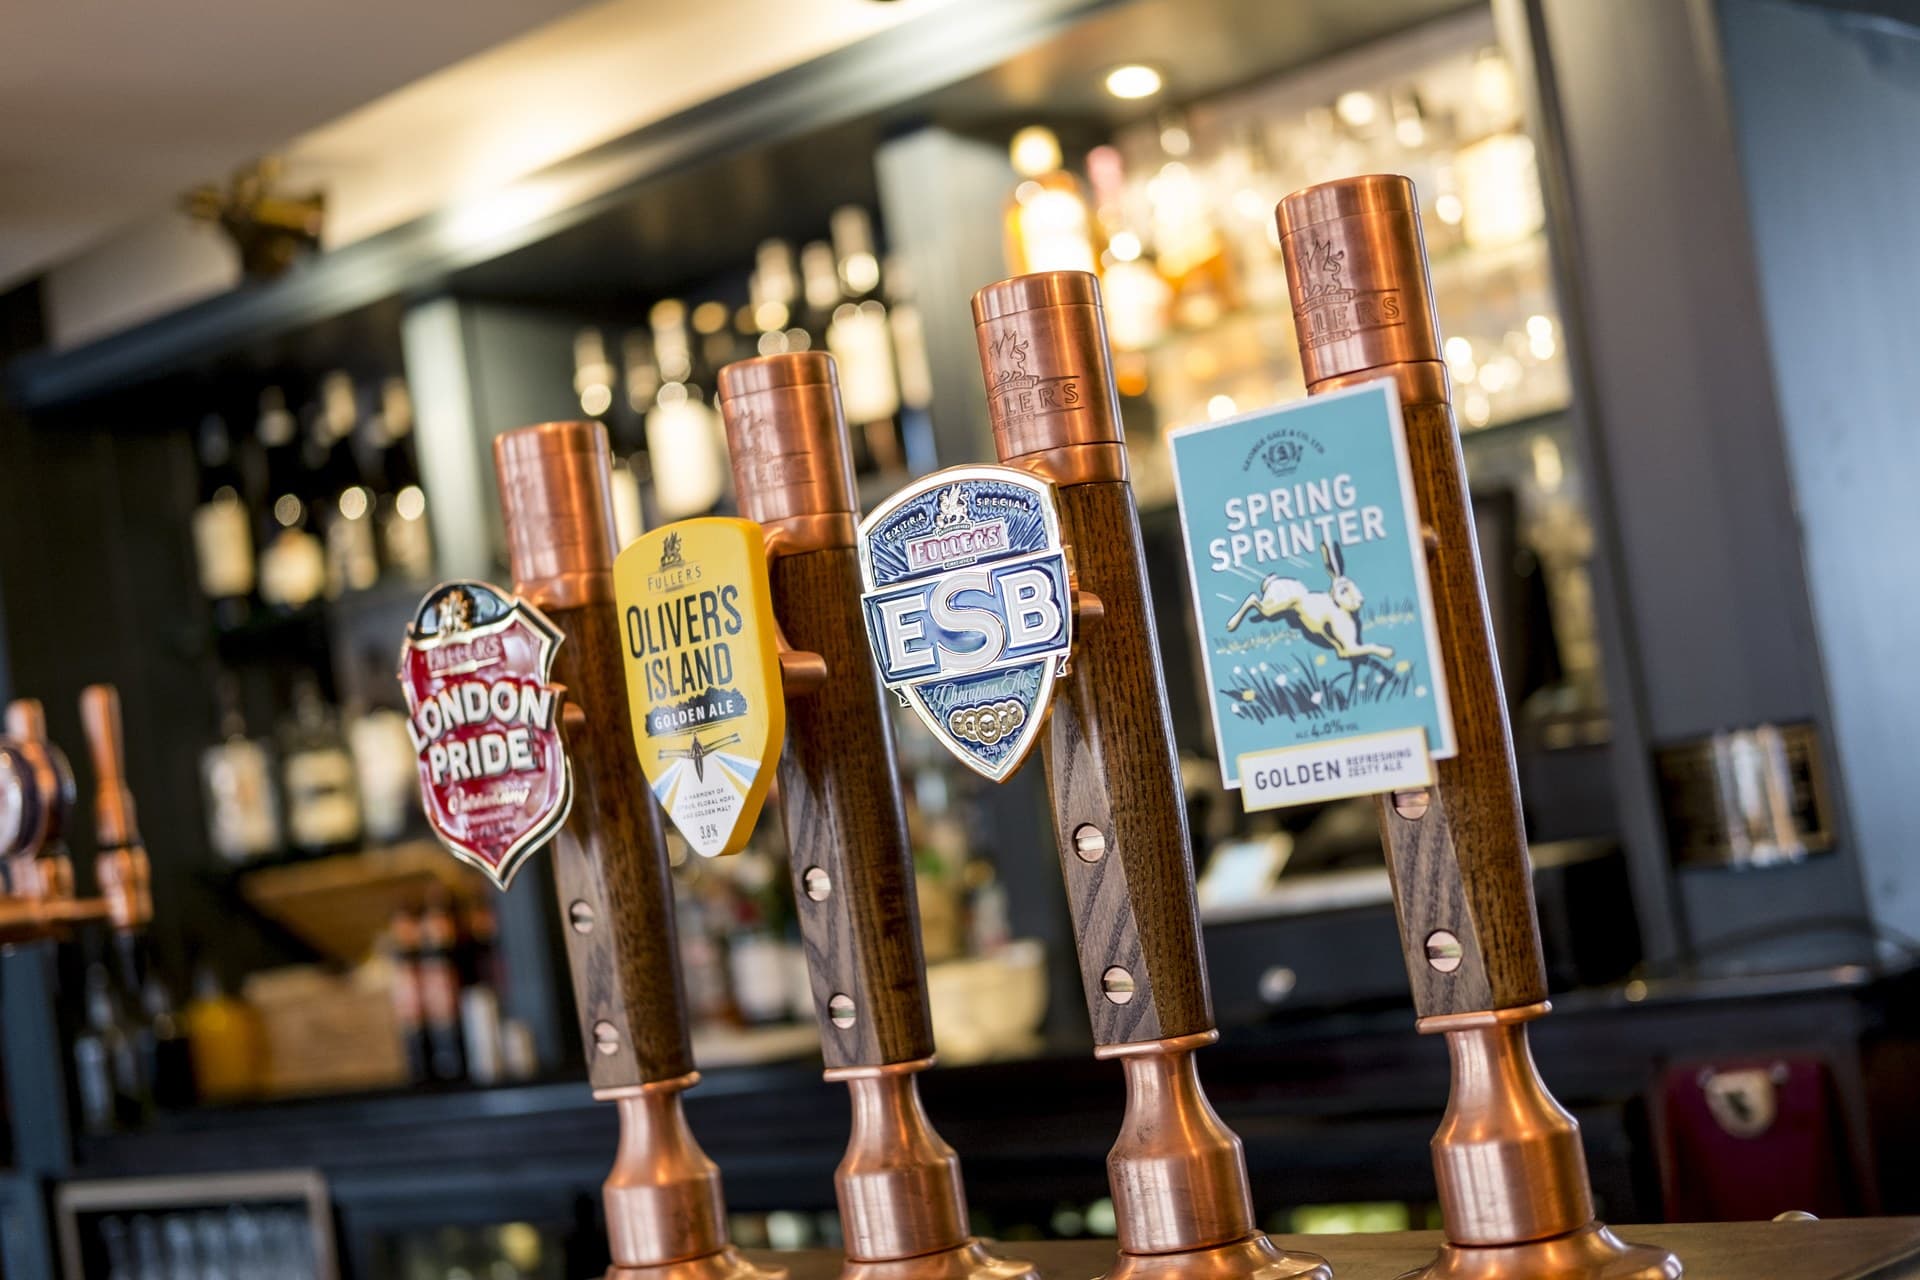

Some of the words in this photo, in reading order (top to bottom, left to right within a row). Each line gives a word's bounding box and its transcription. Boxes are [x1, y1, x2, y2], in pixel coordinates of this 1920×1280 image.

[885, 513, 927, 542] EXTRA
[976, 496, 1030, 512] SPECIAL
[1225, 473, 1356, 532] SPRING
[1209, 505, 1387, 572] SPRINTER
[626, 584, 743, 660] OLIVER'S
[877, 569, 1062, 673] ESB
[645, 642, 733, 703] ISLAND
[406, 681, 553, 753] LONDON
[654, 705, 705, 730] GOLDEN
[709, 700, 735, 716] ALE
[1311, 720, 1344, 737] 4.0%
[428, 728, 535, 784] PRIDE
[1255, 760, 1341, 790] GOLDEN
[1346, 749, 1412, 766] REFRESHING
[1348, 763, 1379, 778] ZESTY
[1384, 761, 1403, 772] ALE
[699, 824, 719, 840] 3.8%
